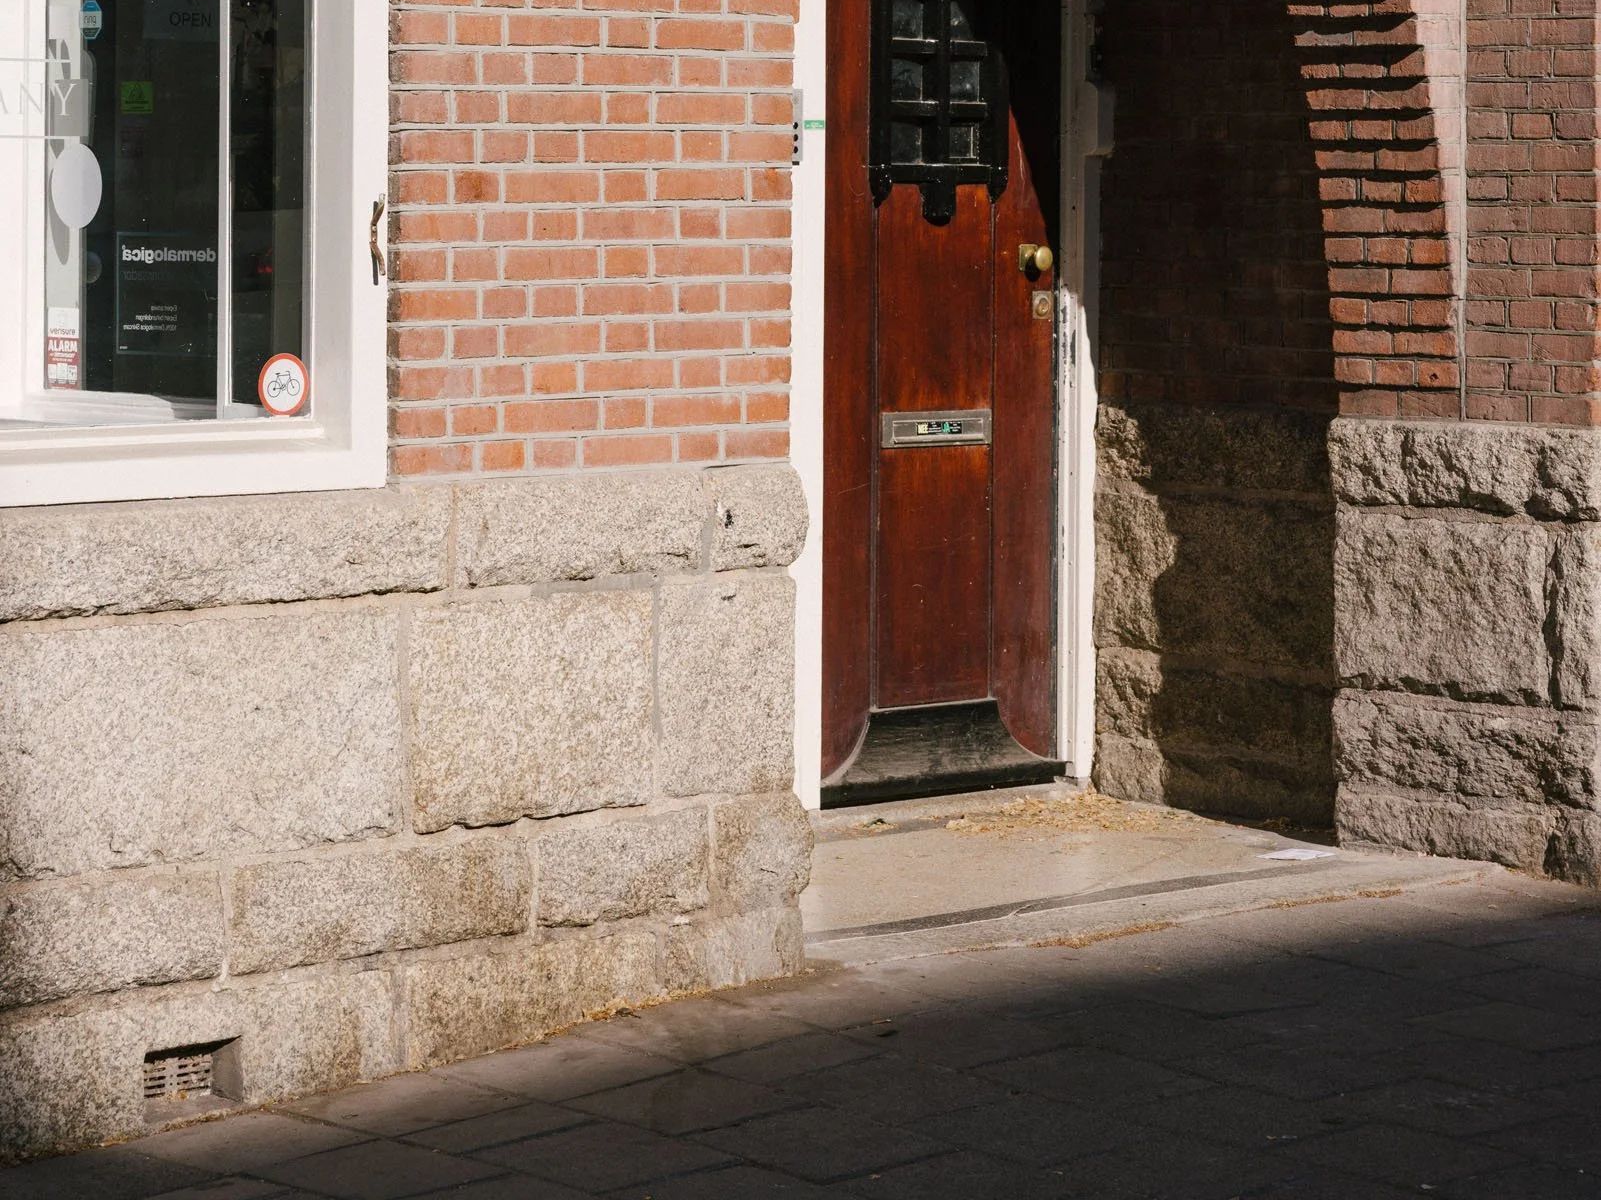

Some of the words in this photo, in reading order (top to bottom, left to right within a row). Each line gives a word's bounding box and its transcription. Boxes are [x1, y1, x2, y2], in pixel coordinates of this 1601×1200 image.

[169, 11, 212, 28] OPEN
[48, 339, 78, 353] ALARM
[917, 423, 929, 434] NEE
